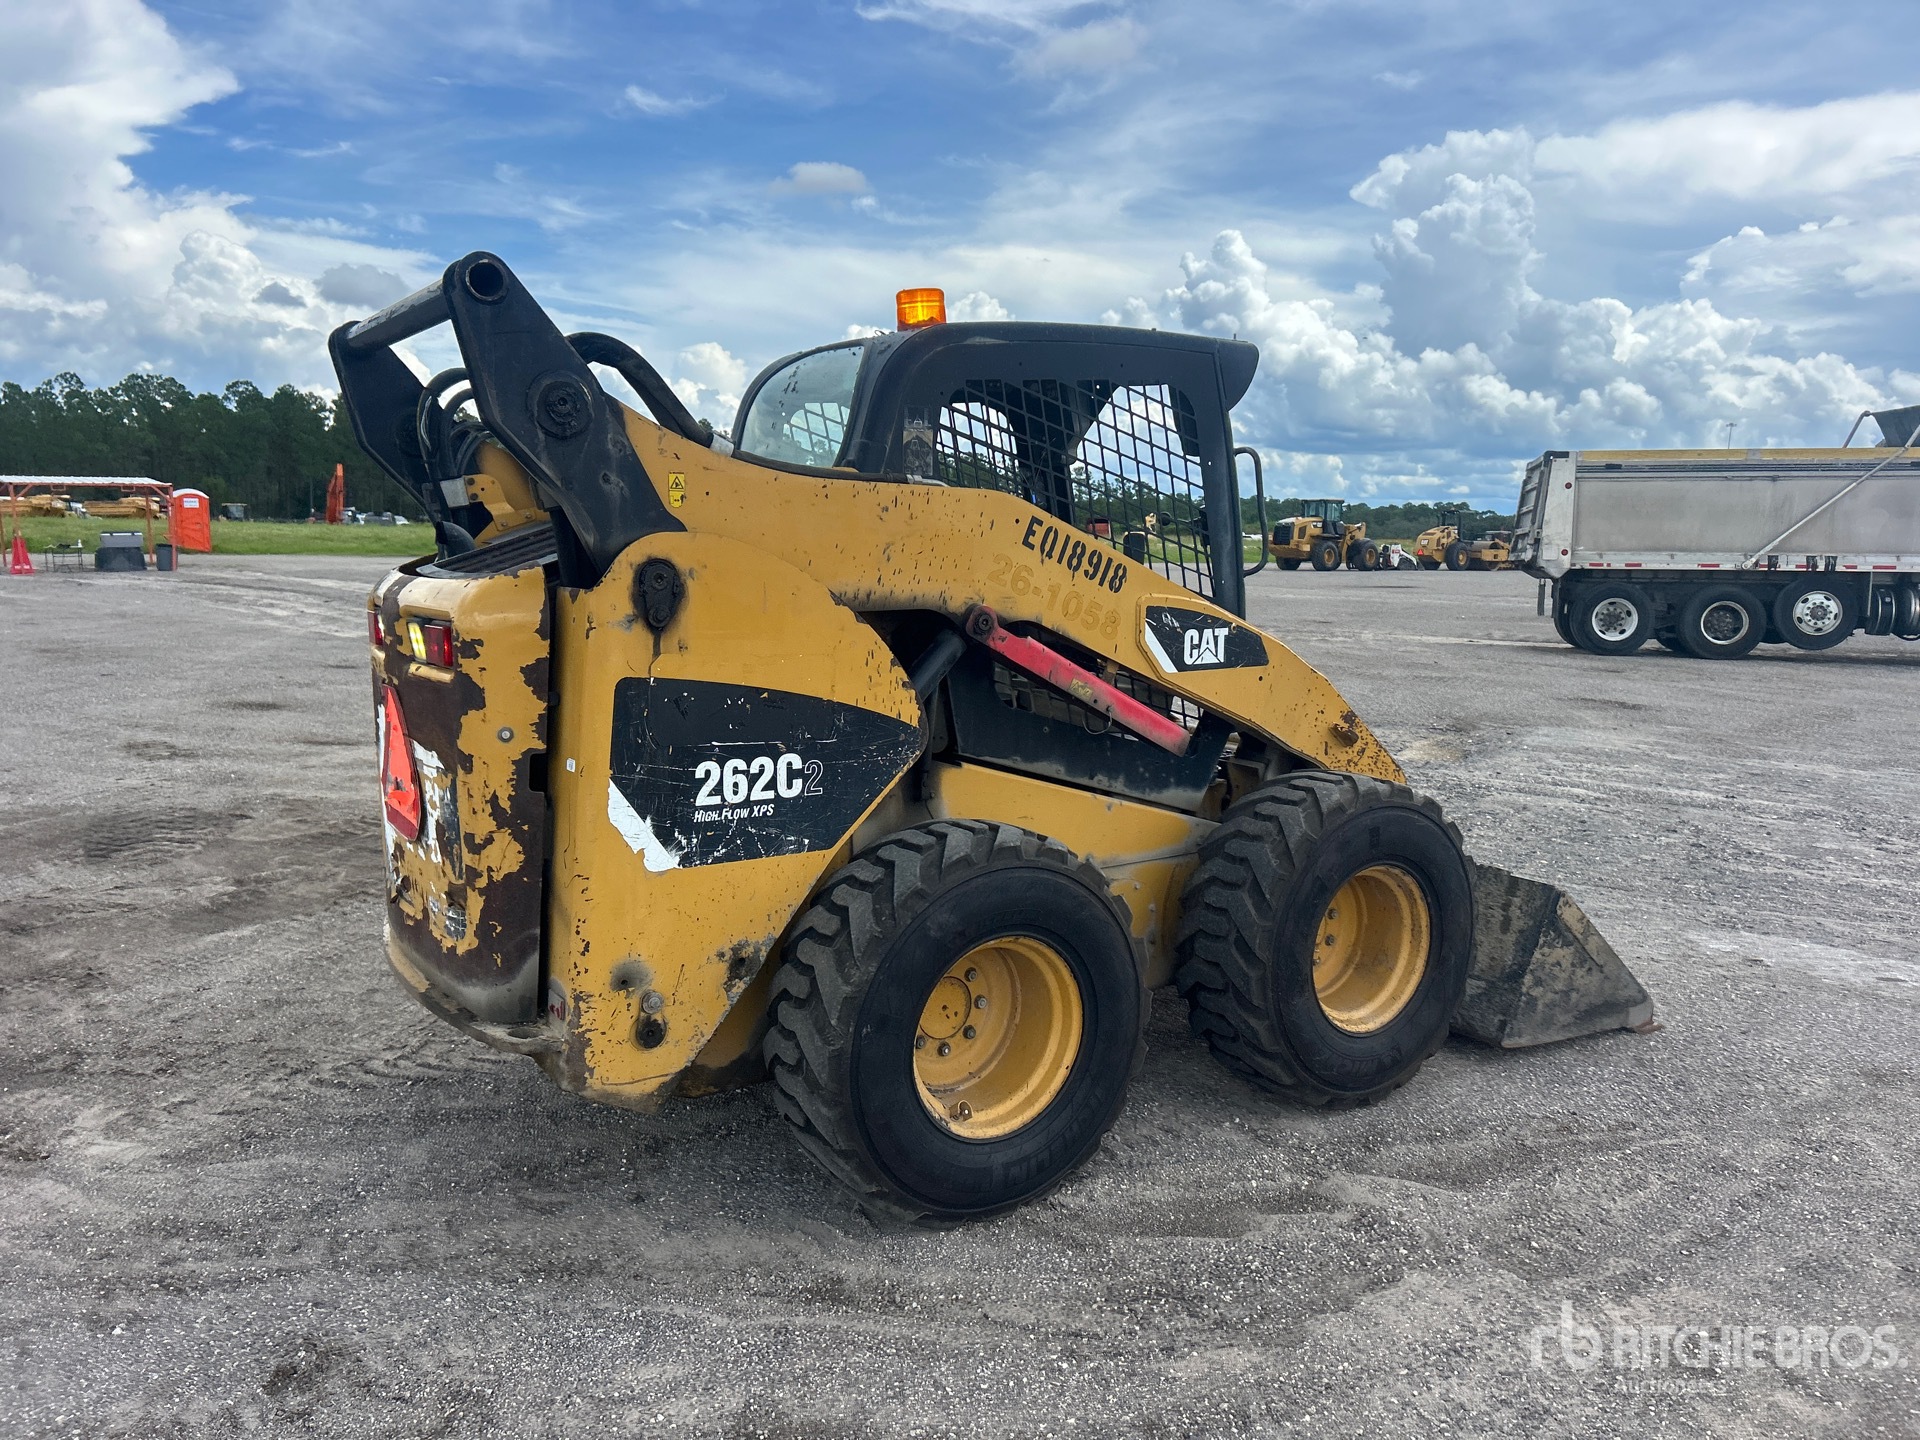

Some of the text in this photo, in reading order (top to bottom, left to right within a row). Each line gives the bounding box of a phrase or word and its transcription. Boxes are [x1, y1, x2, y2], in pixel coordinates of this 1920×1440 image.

[1022, 515, 1128, 593] EQ18918
[988, 554, 1122, 640] 26-1058
[1184, 628, 1229, 665] CAT
[752, 803, 775, 817] XPS
